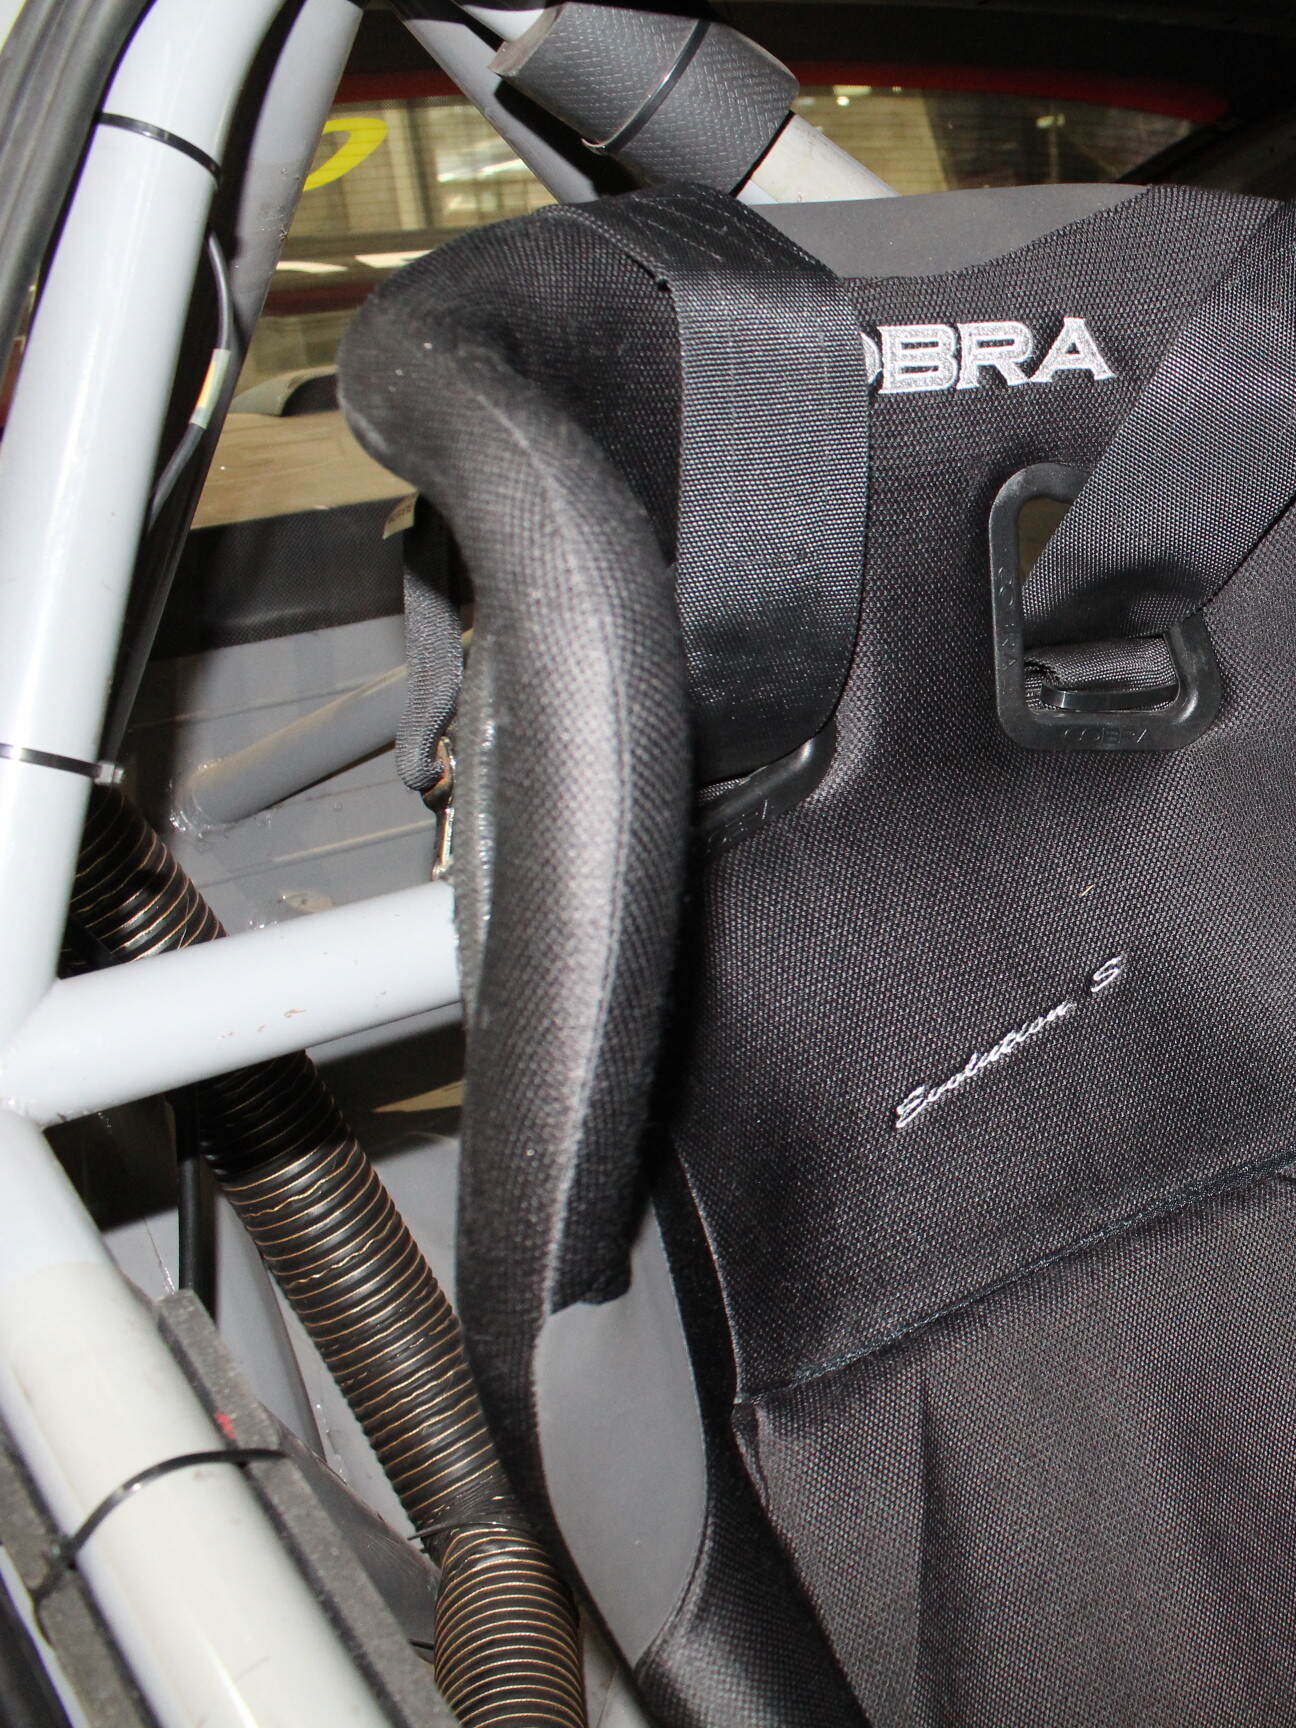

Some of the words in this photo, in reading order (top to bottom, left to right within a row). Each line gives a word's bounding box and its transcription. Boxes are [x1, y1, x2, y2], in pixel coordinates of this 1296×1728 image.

[860, 317, 1117, 394] BRA
[895, 998, 1077, 1129] Evolution
[1091, 954, 1123, 992] S
